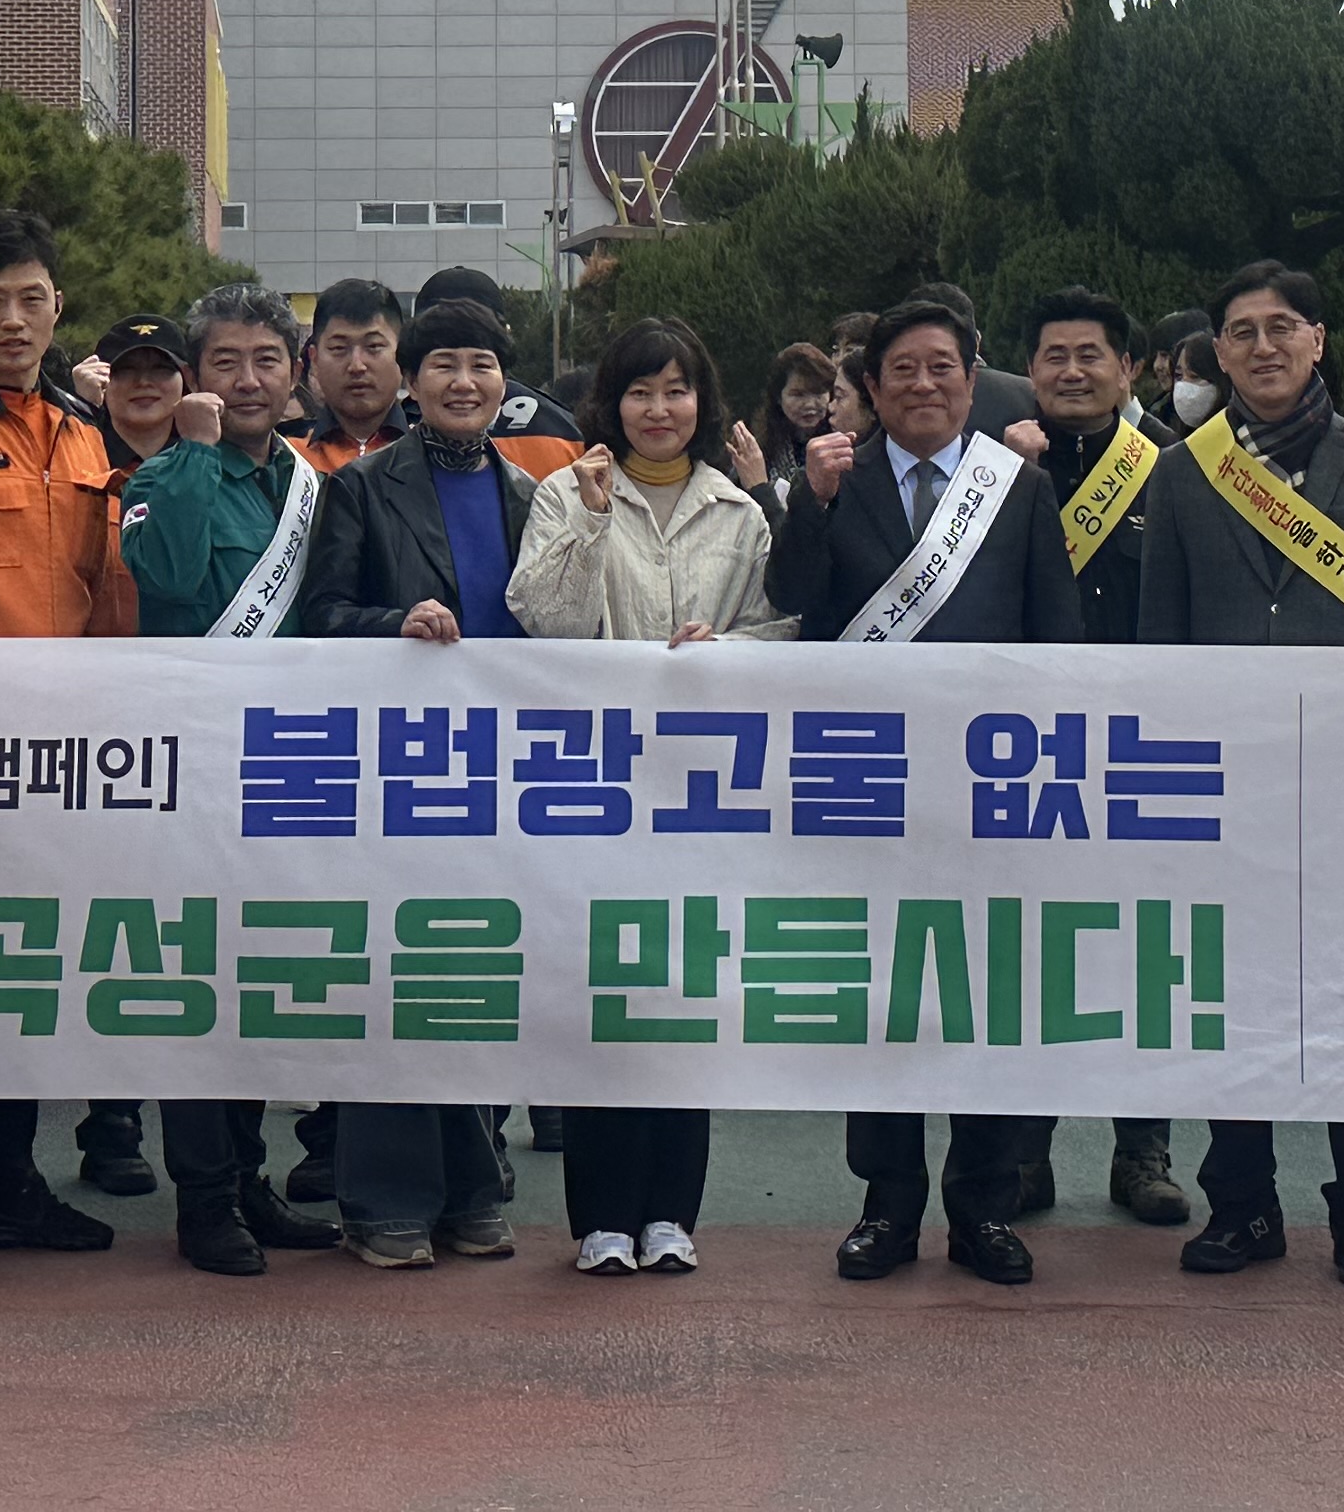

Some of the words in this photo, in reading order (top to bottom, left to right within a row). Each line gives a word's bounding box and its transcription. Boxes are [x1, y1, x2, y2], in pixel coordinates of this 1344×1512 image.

[240, 707, 909, 839] 불법광고물
[965, 713, 1225, 842] 없는
[589, 895, 1225, 1051] 만듭시다!
